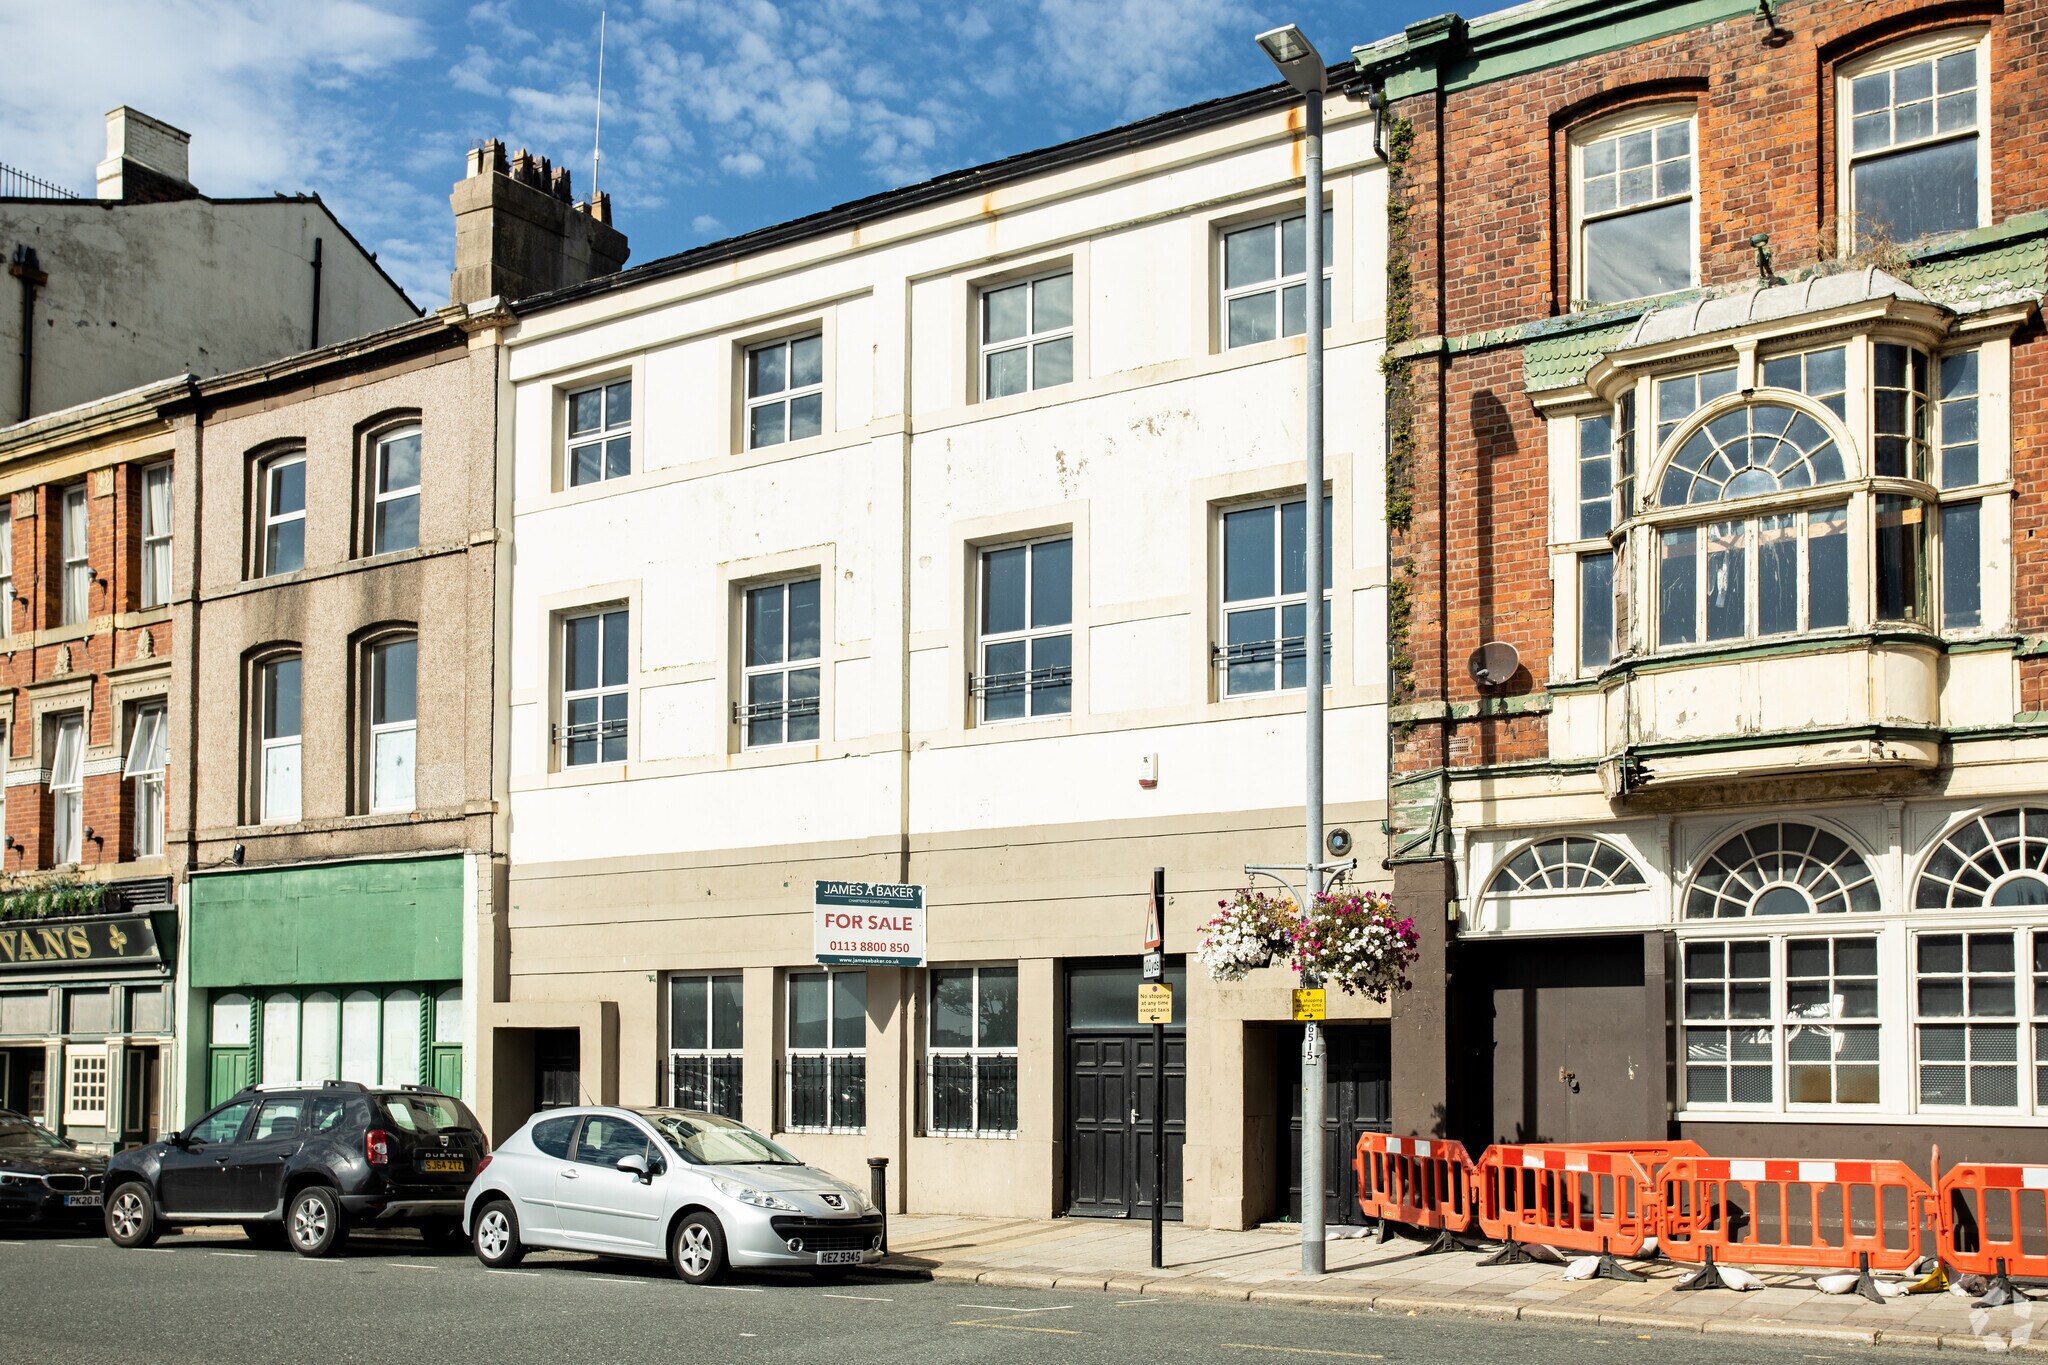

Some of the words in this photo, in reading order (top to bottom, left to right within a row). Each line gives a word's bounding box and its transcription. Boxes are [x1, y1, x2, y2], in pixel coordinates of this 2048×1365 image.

[824, 884, 863, 896] JAMES
[865, 886, 874, 896] A
[876, 886, 914, 898] BAKER
[825, 913, 863, 930] FOR
[868, 915, 913, 931] SALE
[0, 925, 92, 962] VANS
[830, 940, 857, 952] 0113
[860, 942, 887, 953] 8800
[889, 943, 910, 953] 850
[425, 1160, 447, 1170] SJ64
[448, 1160, 463, 1170] ZTZ
[70, 1196, 93, 1205] PK20
[821, 1252, 839, 1263] KEZ
[840, 1251, 861, 1263] 9345
